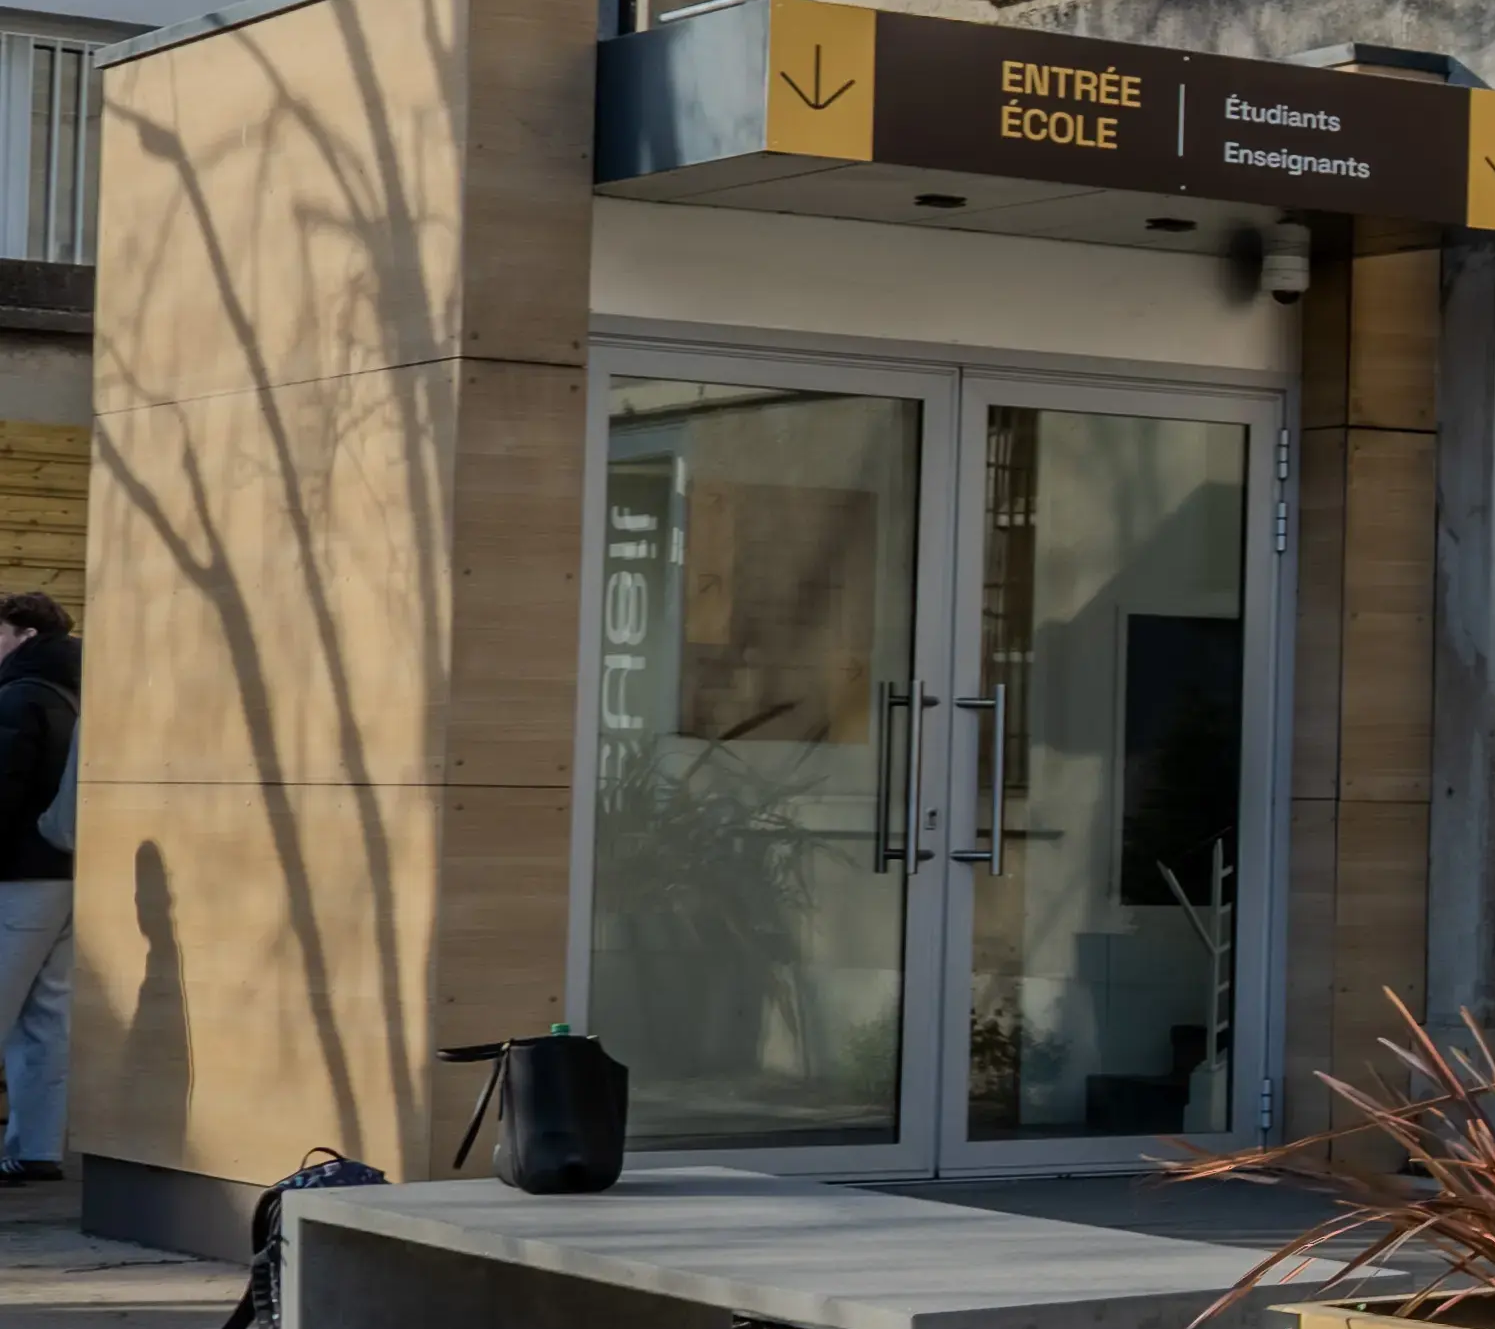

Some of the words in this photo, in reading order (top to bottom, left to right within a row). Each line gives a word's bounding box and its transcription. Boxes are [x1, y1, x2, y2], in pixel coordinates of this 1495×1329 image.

[1000, 58, 1143, 109] ENTRÉE
[999, 104, 1120, 151] ÉCOLE
[1223, 93, 1342, 134] Étudiants
[1223, 140, 1372, 182] Enseignants
